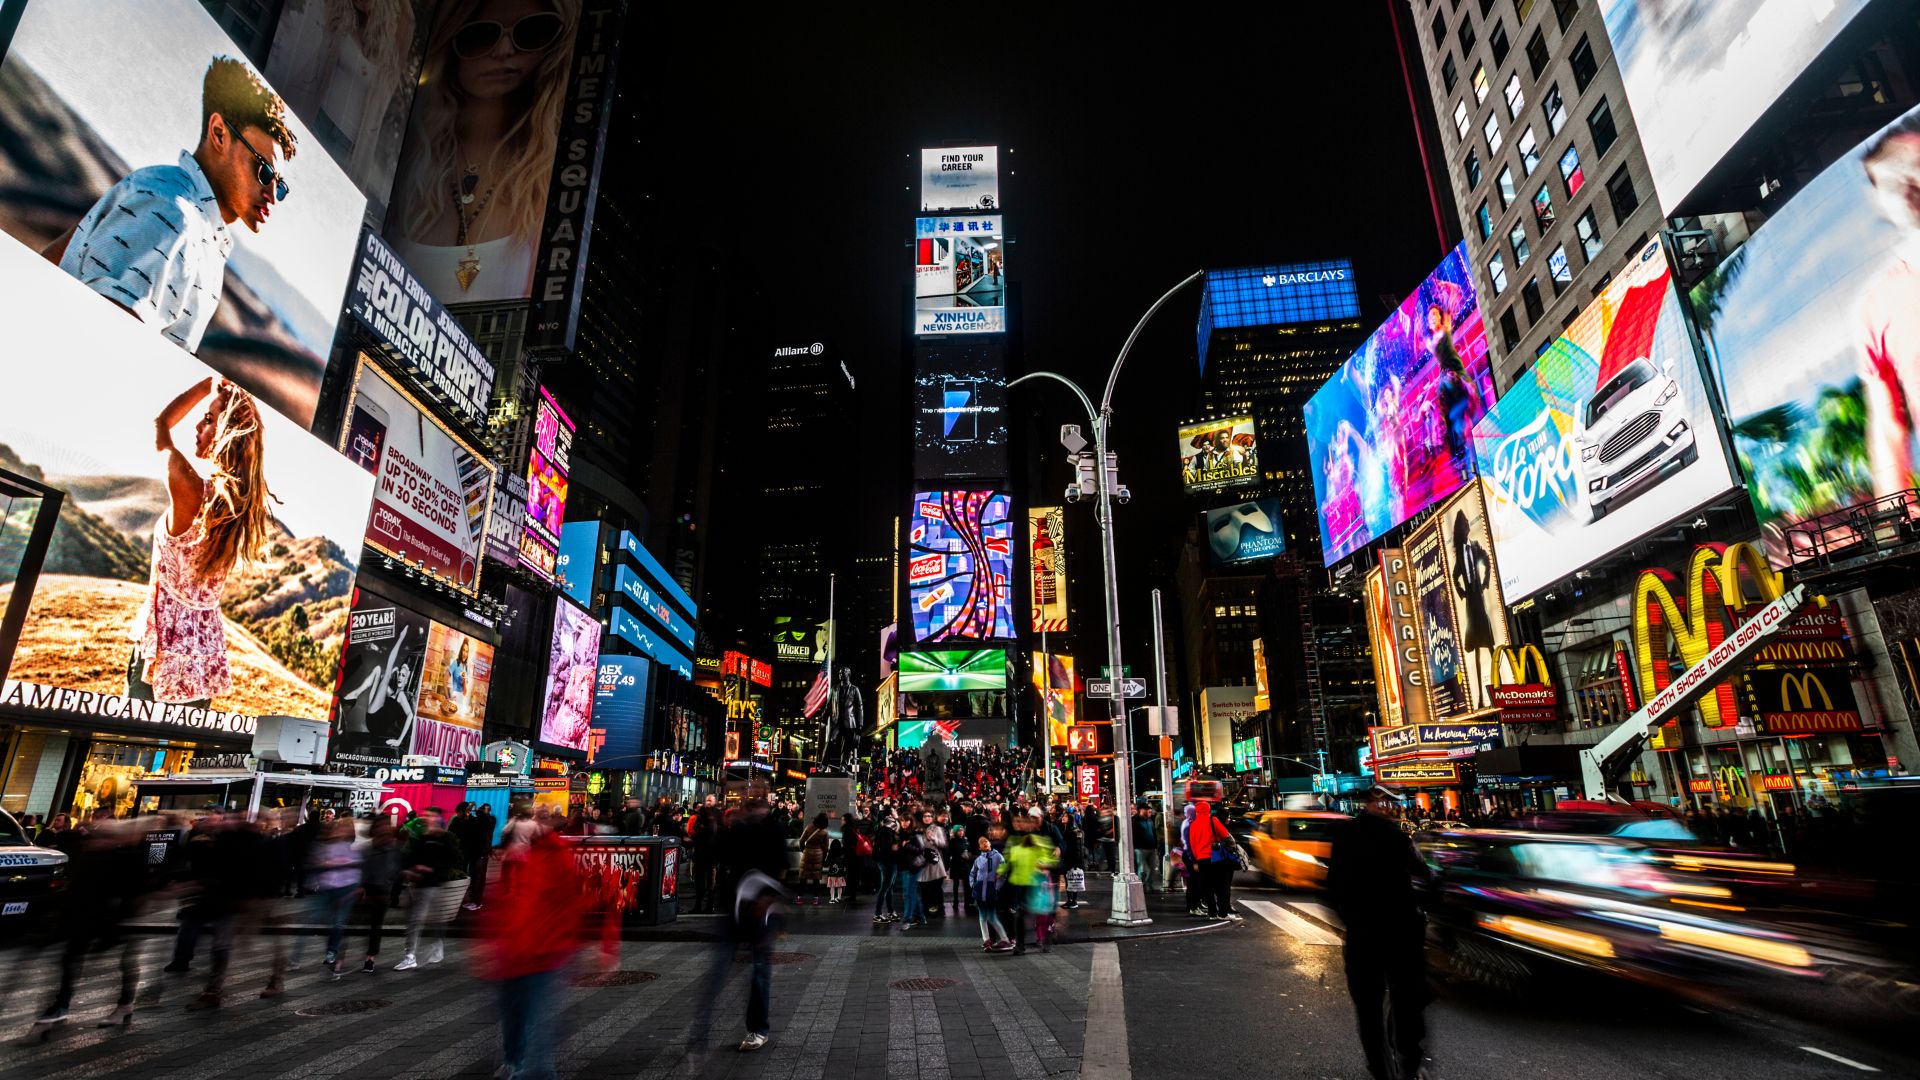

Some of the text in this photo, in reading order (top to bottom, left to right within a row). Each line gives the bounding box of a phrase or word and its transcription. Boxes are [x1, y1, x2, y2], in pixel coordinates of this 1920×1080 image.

[543, 9, 613, 301] TIMES SQUARE
[941, 154, 984, 163] FIND YOUR
[941, 163, 973, 171] CAREER
[1279, 269, 1345, 285] BARCLAYS
[366, 233, 496, 383] CYNTHIA ERIVO JENNIFER HUDSON
[934, 312, 986, 323] XINHUA
[538, 322, 560, 331] NYC
[923, 322, 998, 331] NEWS AGENCY
[356, 257, 492, 416] THE COLOR PURPLE
[374, 316, 419, 363] MIRACLE
[419, 355, 433, 378] ON
[774, 346, 809, 357] Allianz
[357, 433, 377, 451] TODAY
[1208, 460, 1228, 471] Les
[388, 446, 461, 506] BROADWAY TICKETS
[385, 459, 460, 519] UP TO 50% OFF
[507, 480, 529, 501] HUDSON
[381, 476, 457, 534] IN 30 SECONDS
[491, 487, 526, 527] COLOR
[379, 507, 402, 527] TODAY
[382, 519, 395, 536] TIX
[488, 511, 523, 549] URPLE
[402, 529, 451, 566] The Broadway Ticket App
[628, 538, 636, 552] AEX
[1240, 537, 1282, 550] PHANTOM
[911, 559, 942, 577] Coca-Cola
[632, 580, 650, 606] 437.49
[352, 611, 394, 628] 20 YEARS
[1391, 557, 1423, 687] PALACE
[598, 665, 623, 675] AEX
[1647, 605, 1783, 719] NORTH SHORE NEON SIGN CO.
[598, 675, 635, 686] 437.49
[1103, 668, 1110, 678] W
[1092, 684, 1110, 692] ONE
[1494, 690, 1555, 700] McDonald's
[4, 681, 257, 734] AMERICAN EAGLE OU
[414, 718, 481, 768] WAITRESS
[960, 739, 982, 748] LUXURY
[1087, 731, 1096, 749] 9
[189, 754, 247, 769] snackBOX
[336, 752, 401, 765] CHICAGOTHEMUSICAL.COM
[390, 768, 425, 781] NYC
[444, 768, 456, 776] Official
[1082, 767, 1096, 794] tkts
[0, 857, 39, 866] POLICE
[610, 852, 645, 877] BOYS
